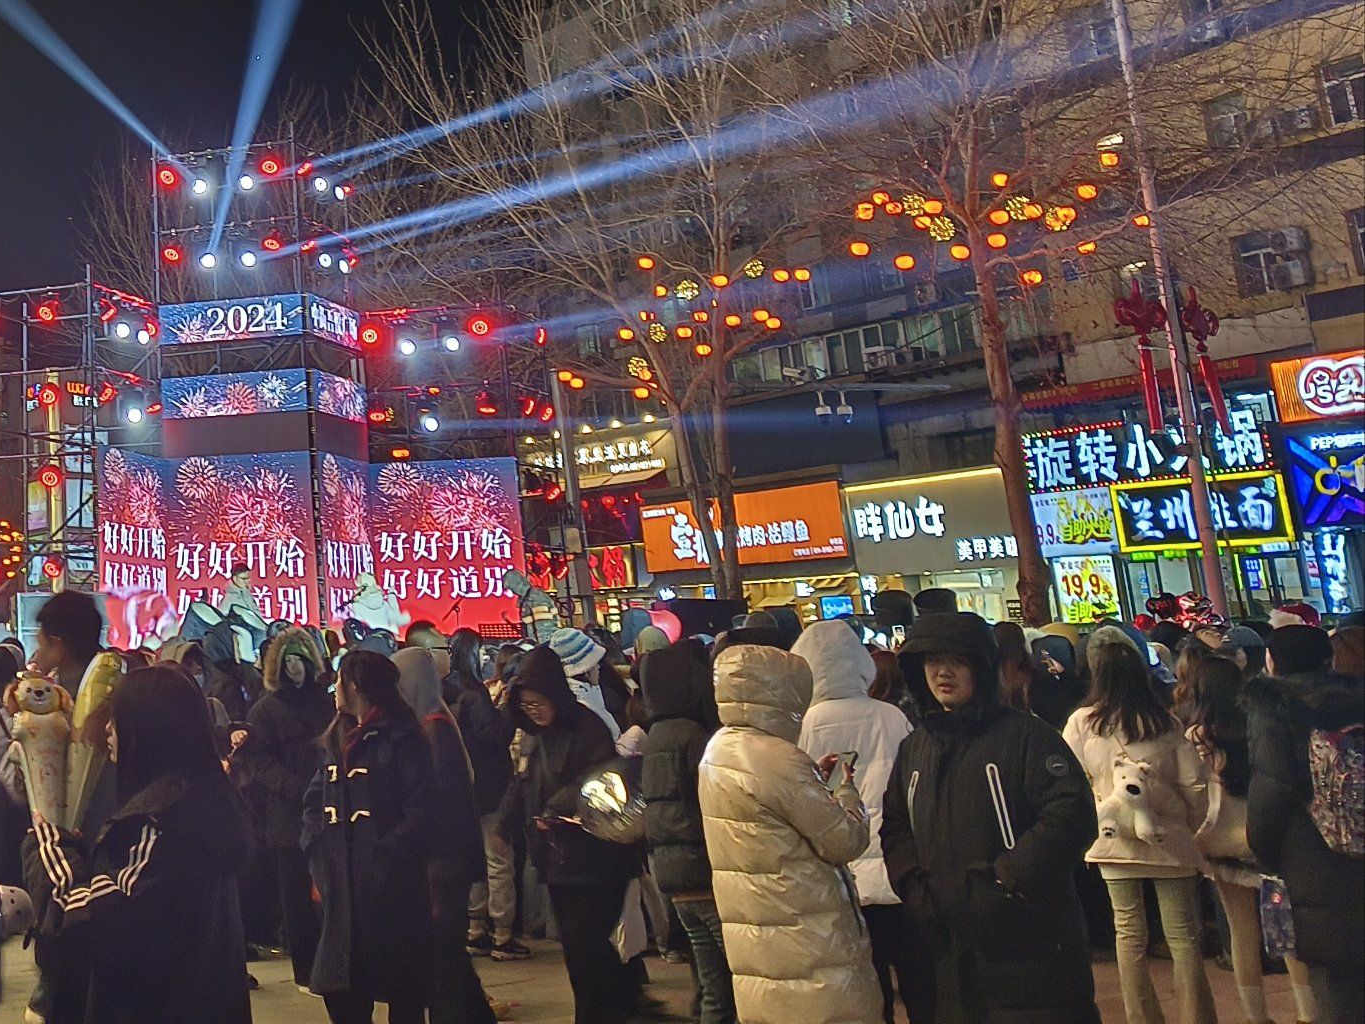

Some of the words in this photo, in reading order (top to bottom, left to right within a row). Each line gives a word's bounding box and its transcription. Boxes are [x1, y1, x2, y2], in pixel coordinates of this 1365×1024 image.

[206, 302, 288, 336] 2024
[1024, 410, 1265, 489] 旋转小火锅
[103, 520, 167, 561] 好好开始
[175, 539, 306, 581] 好好开始
[380, 527, 512, 563] 好好开始
[381, 564, 516, 601] 好好道别
[176, 584, 310, 626] 好道别
